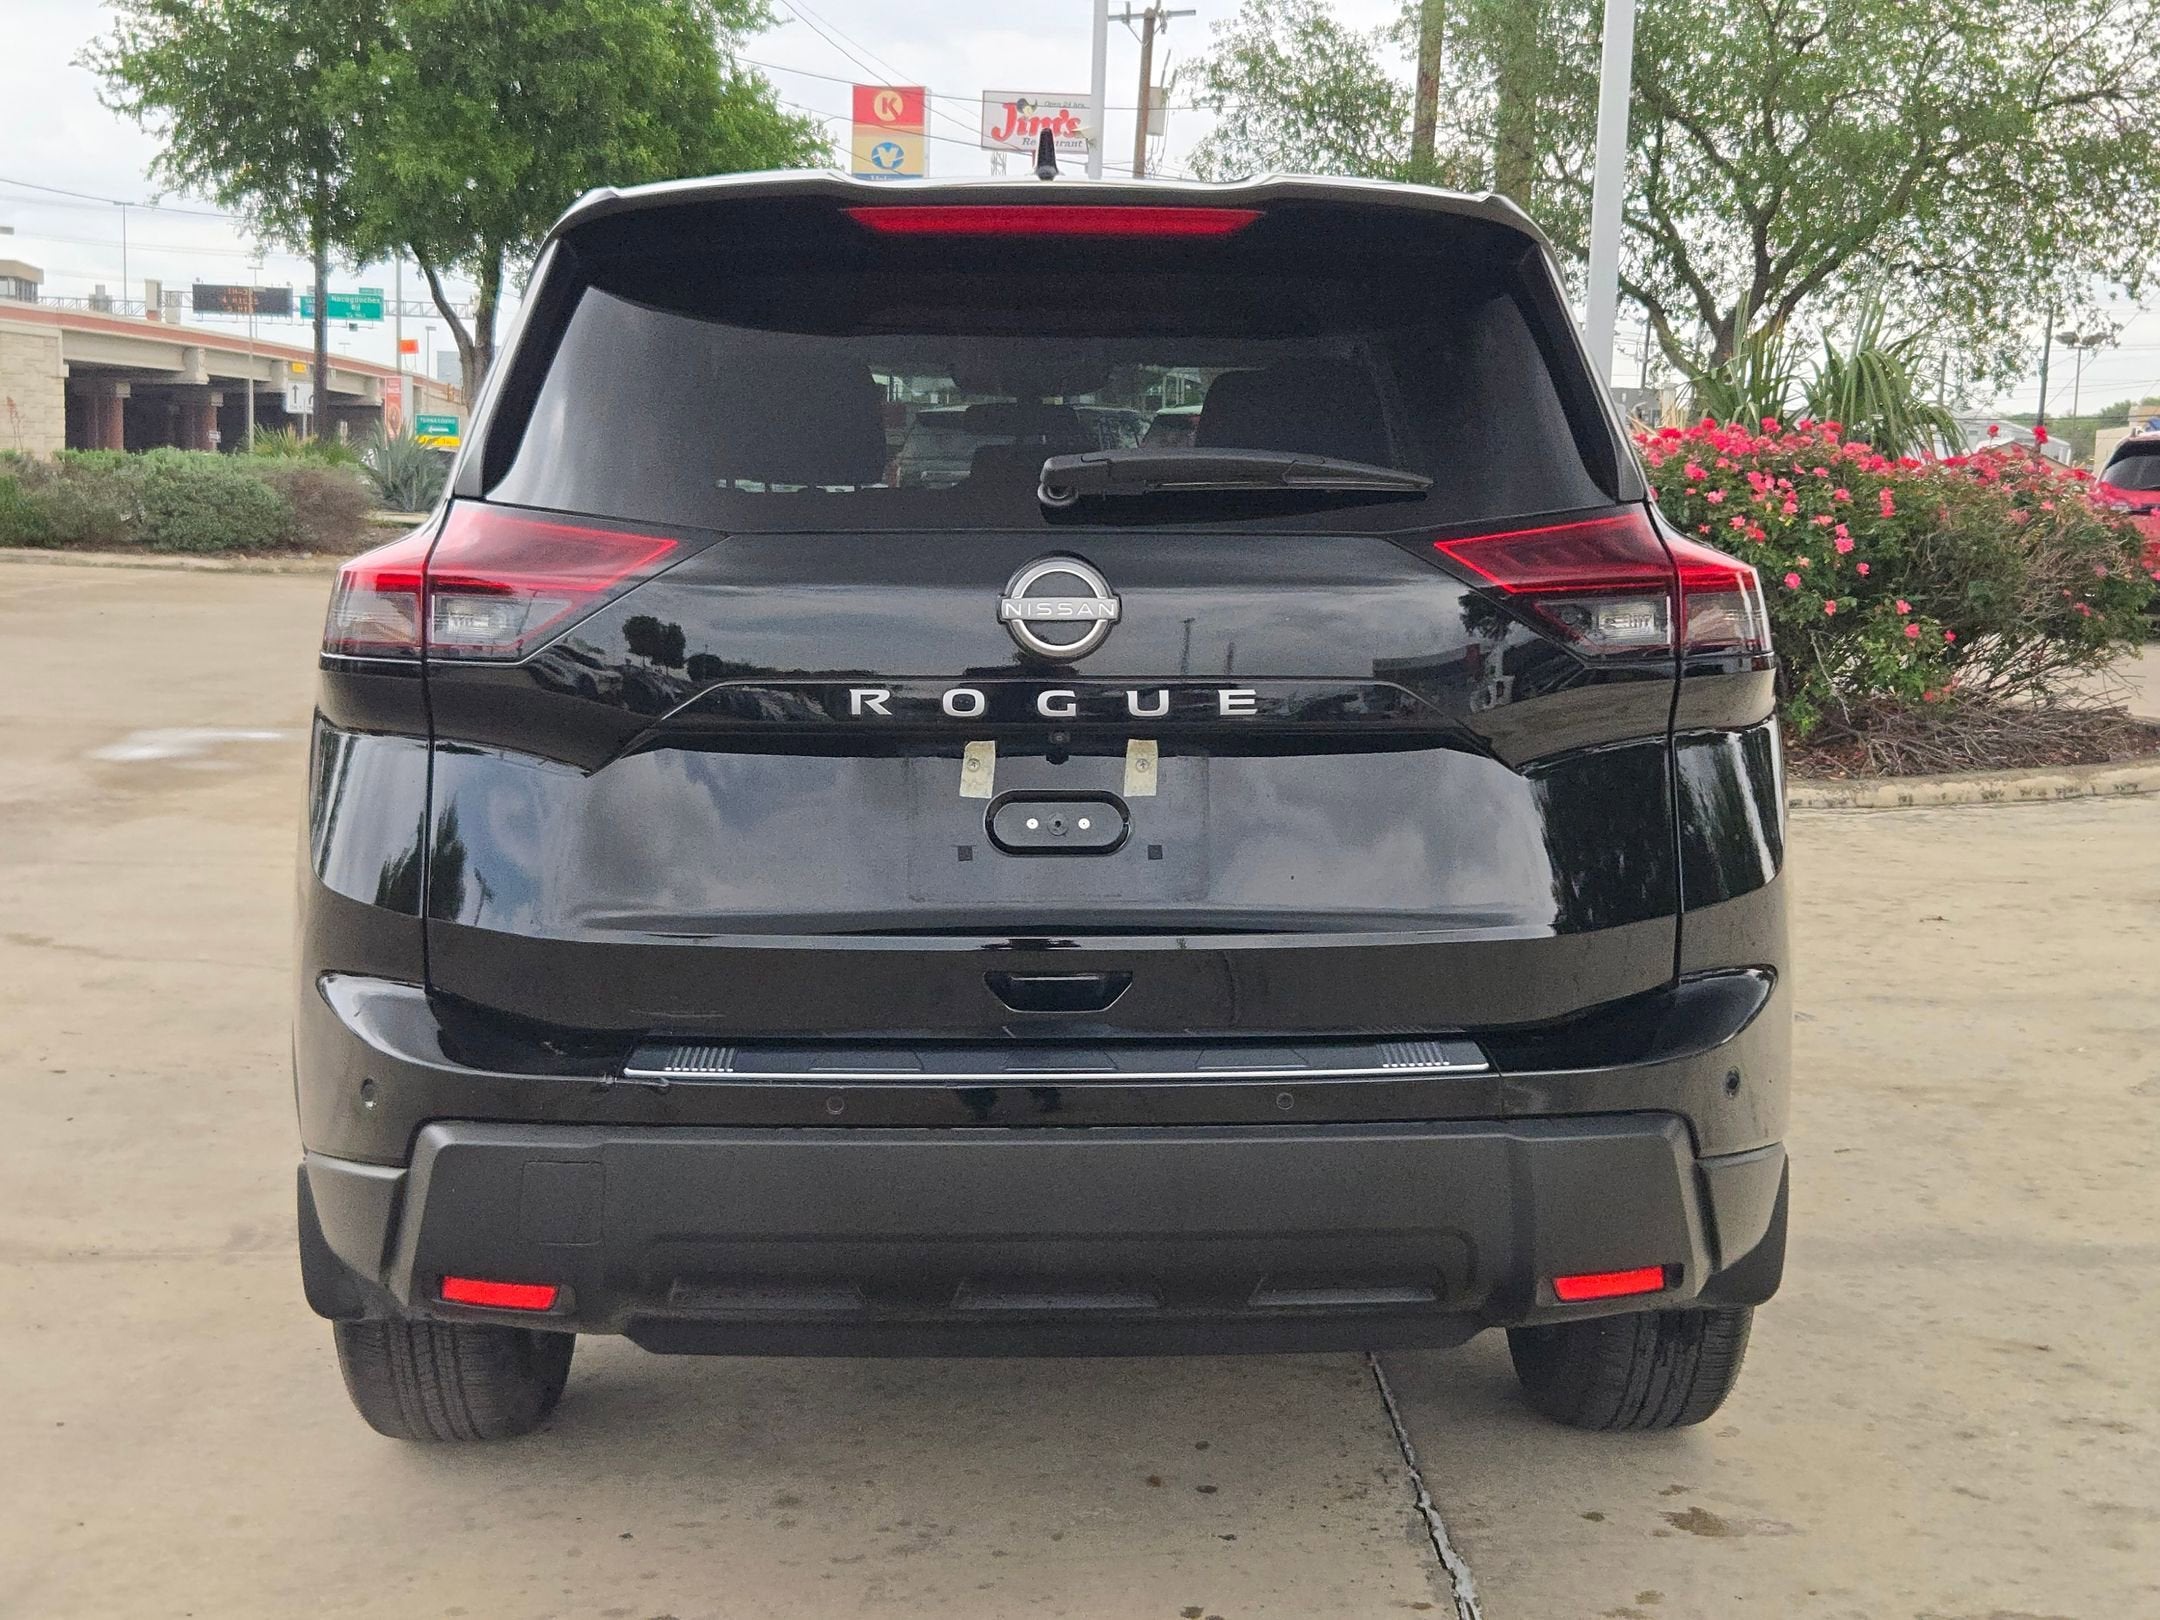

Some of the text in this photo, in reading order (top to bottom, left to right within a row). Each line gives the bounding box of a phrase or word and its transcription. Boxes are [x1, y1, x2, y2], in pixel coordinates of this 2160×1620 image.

[991, 102, 1081, 142] Jim's
[1005, 602, 1115, 617] NISSAN
[849, 689, 1258, 717] ROGUE
